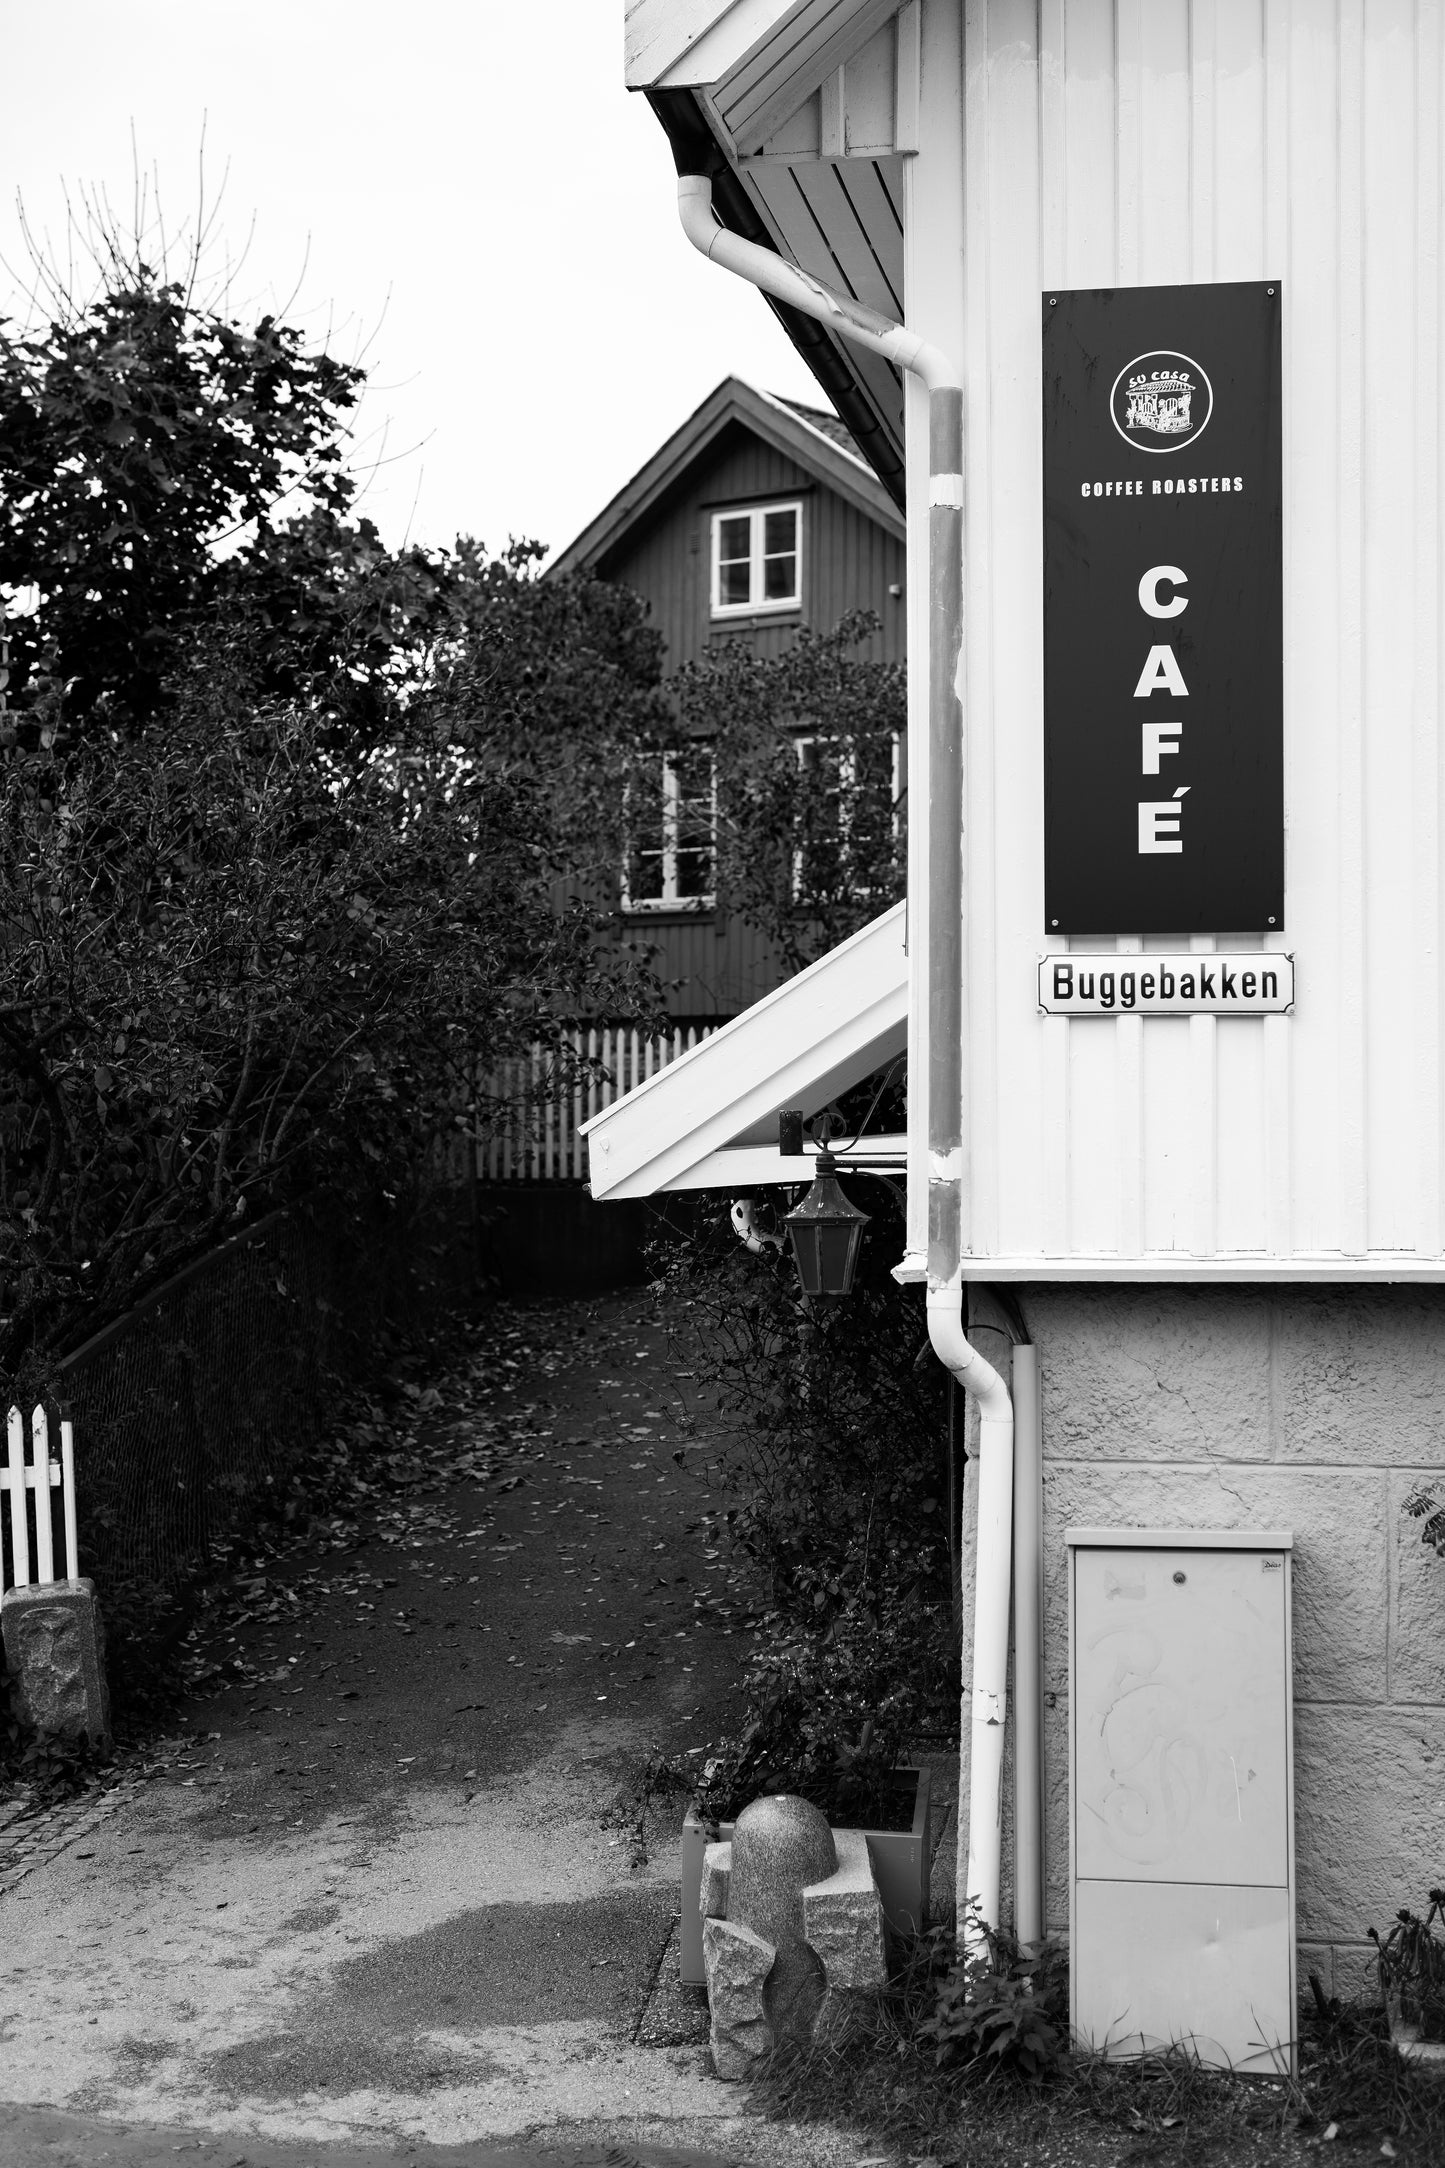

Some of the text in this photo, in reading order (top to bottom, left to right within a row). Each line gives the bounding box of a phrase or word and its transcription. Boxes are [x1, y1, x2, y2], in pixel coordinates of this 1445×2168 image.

[1151, 370, 1190, 382] casa
[1081, 477, 1243, 497] COFFEE ROASTERS
[1133, 565, 1192, 854] CAFÉ
[1053, 963, 1278, 1008] Buggebakken
